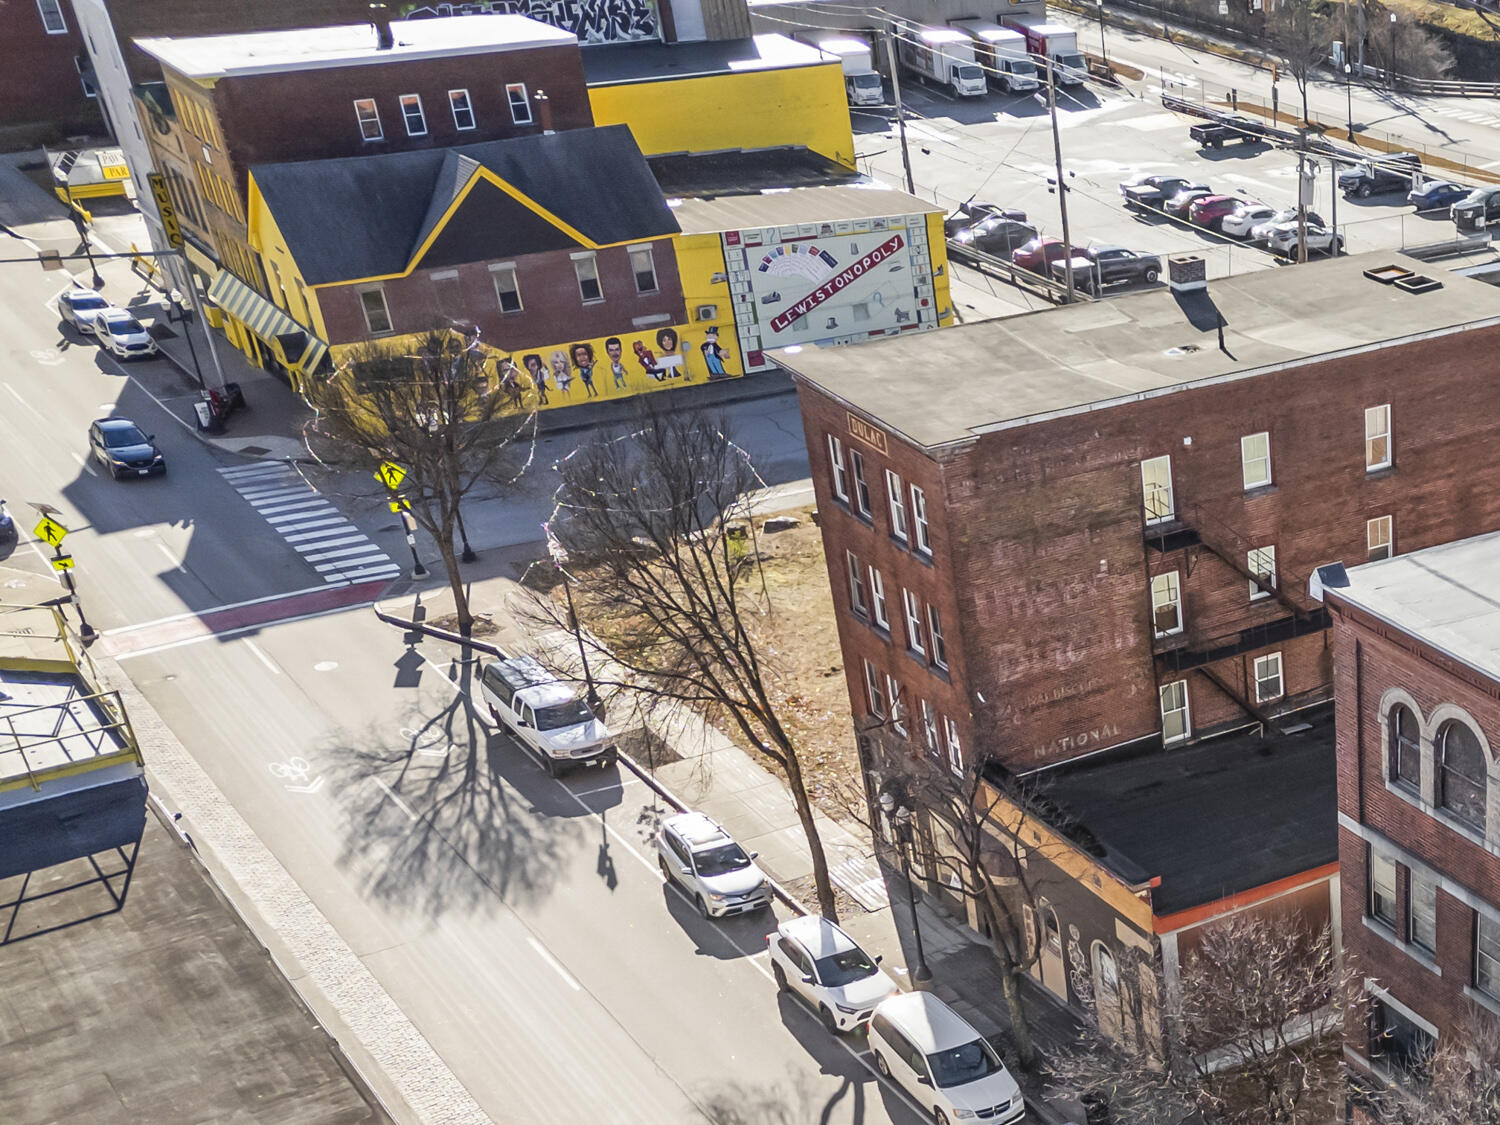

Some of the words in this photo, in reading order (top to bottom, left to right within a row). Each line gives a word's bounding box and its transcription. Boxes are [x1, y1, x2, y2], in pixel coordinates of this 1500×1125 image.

[152, 178, 184, 245] MUSIC
[775, 237, 898, 329] LEWISTONOPOLY
[851, 417, 883, 448] DULAC
[1034, 724, 1119, 759] NATIONAL
